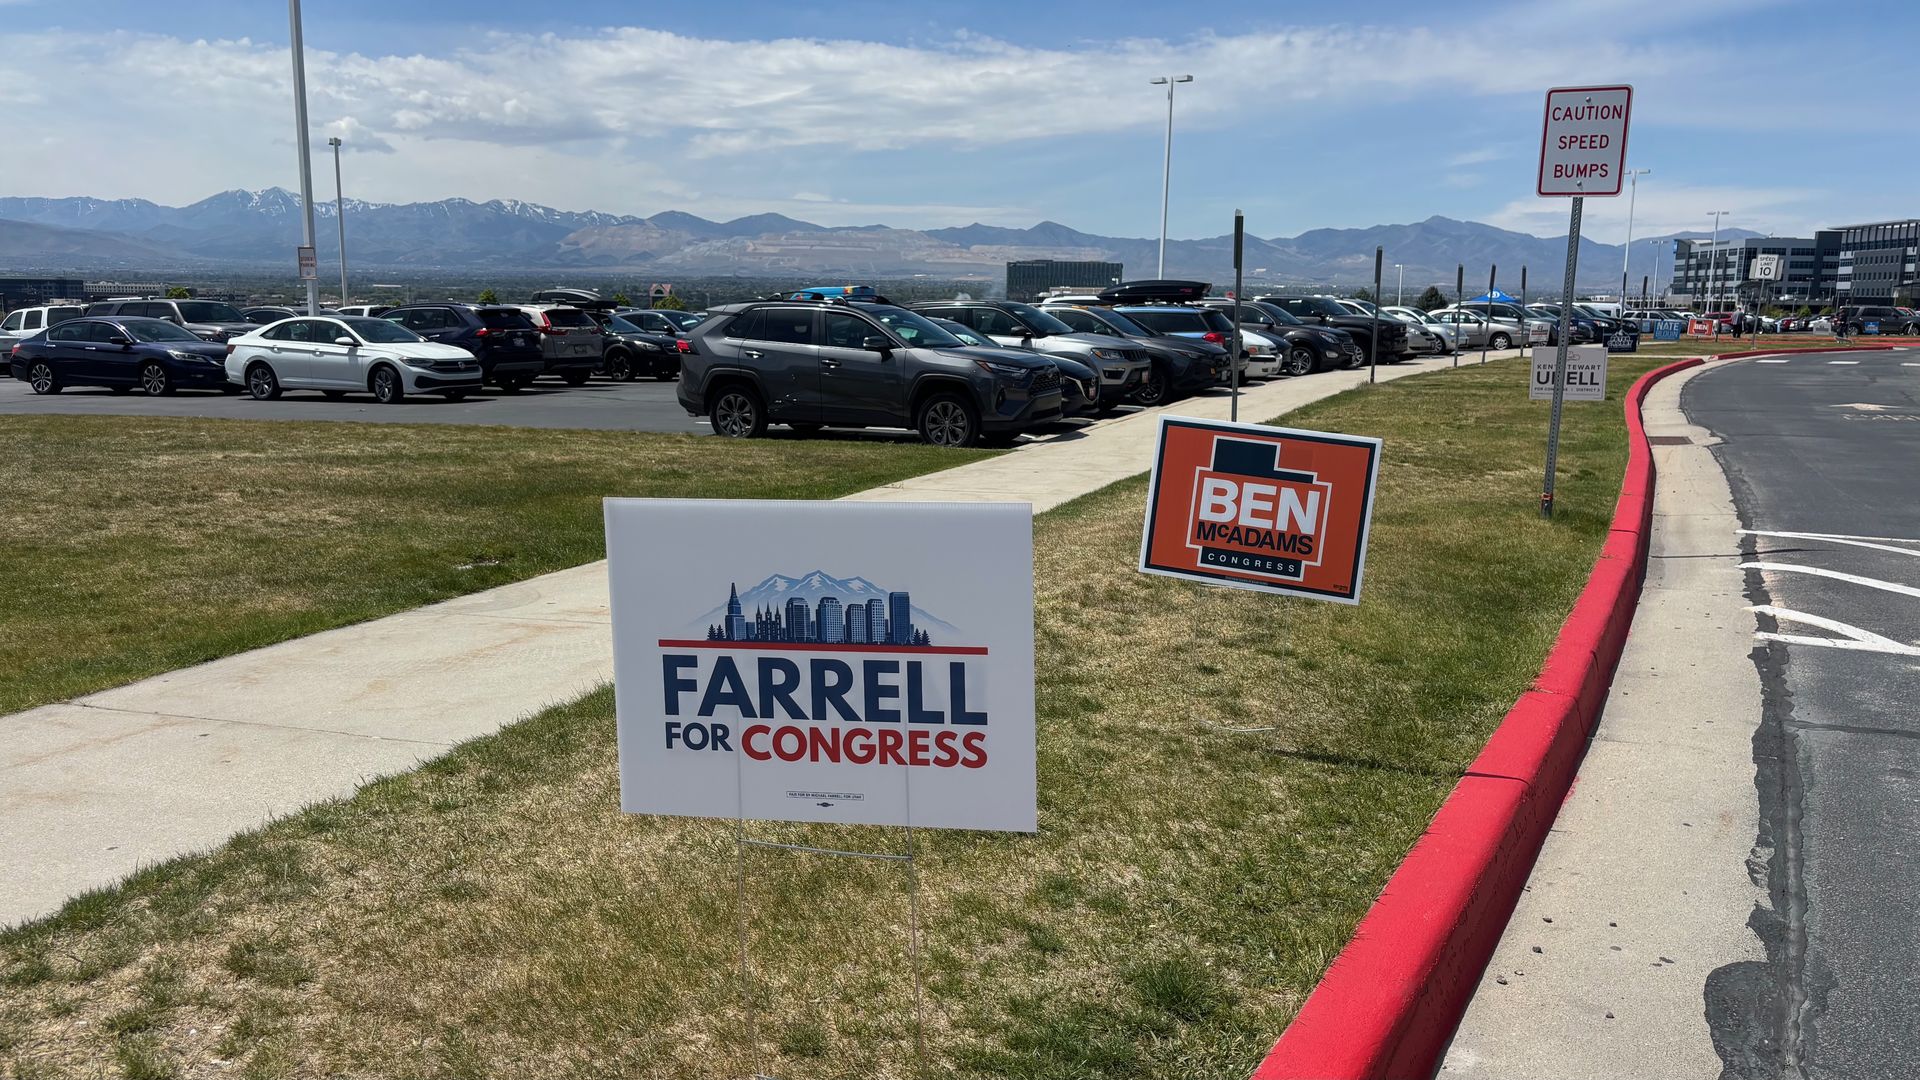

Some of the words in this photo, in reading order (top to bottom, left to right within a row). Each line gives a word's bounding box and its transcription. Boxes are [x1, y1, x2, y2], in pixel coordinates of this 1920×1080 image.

[1552, 105, 1623, 121] CAUTION
[1558, 134, 1609, 150] SPEED
[1553, 163, 1609, 179] BUMPS
[1760, 267, 1771, 276] 10
[1656, 321, 1679, 331] NATE
[1199, 477, 1320, 535] BEN
[1197, 522, 1313, 555] McADAMS
[1208, 553, 1295, 573] CONGRESS
[662, 654, 988, 725] FARRELL
[665, 721, 733, 752] FOR
[741, 724, 988, 769] CONGRESS
